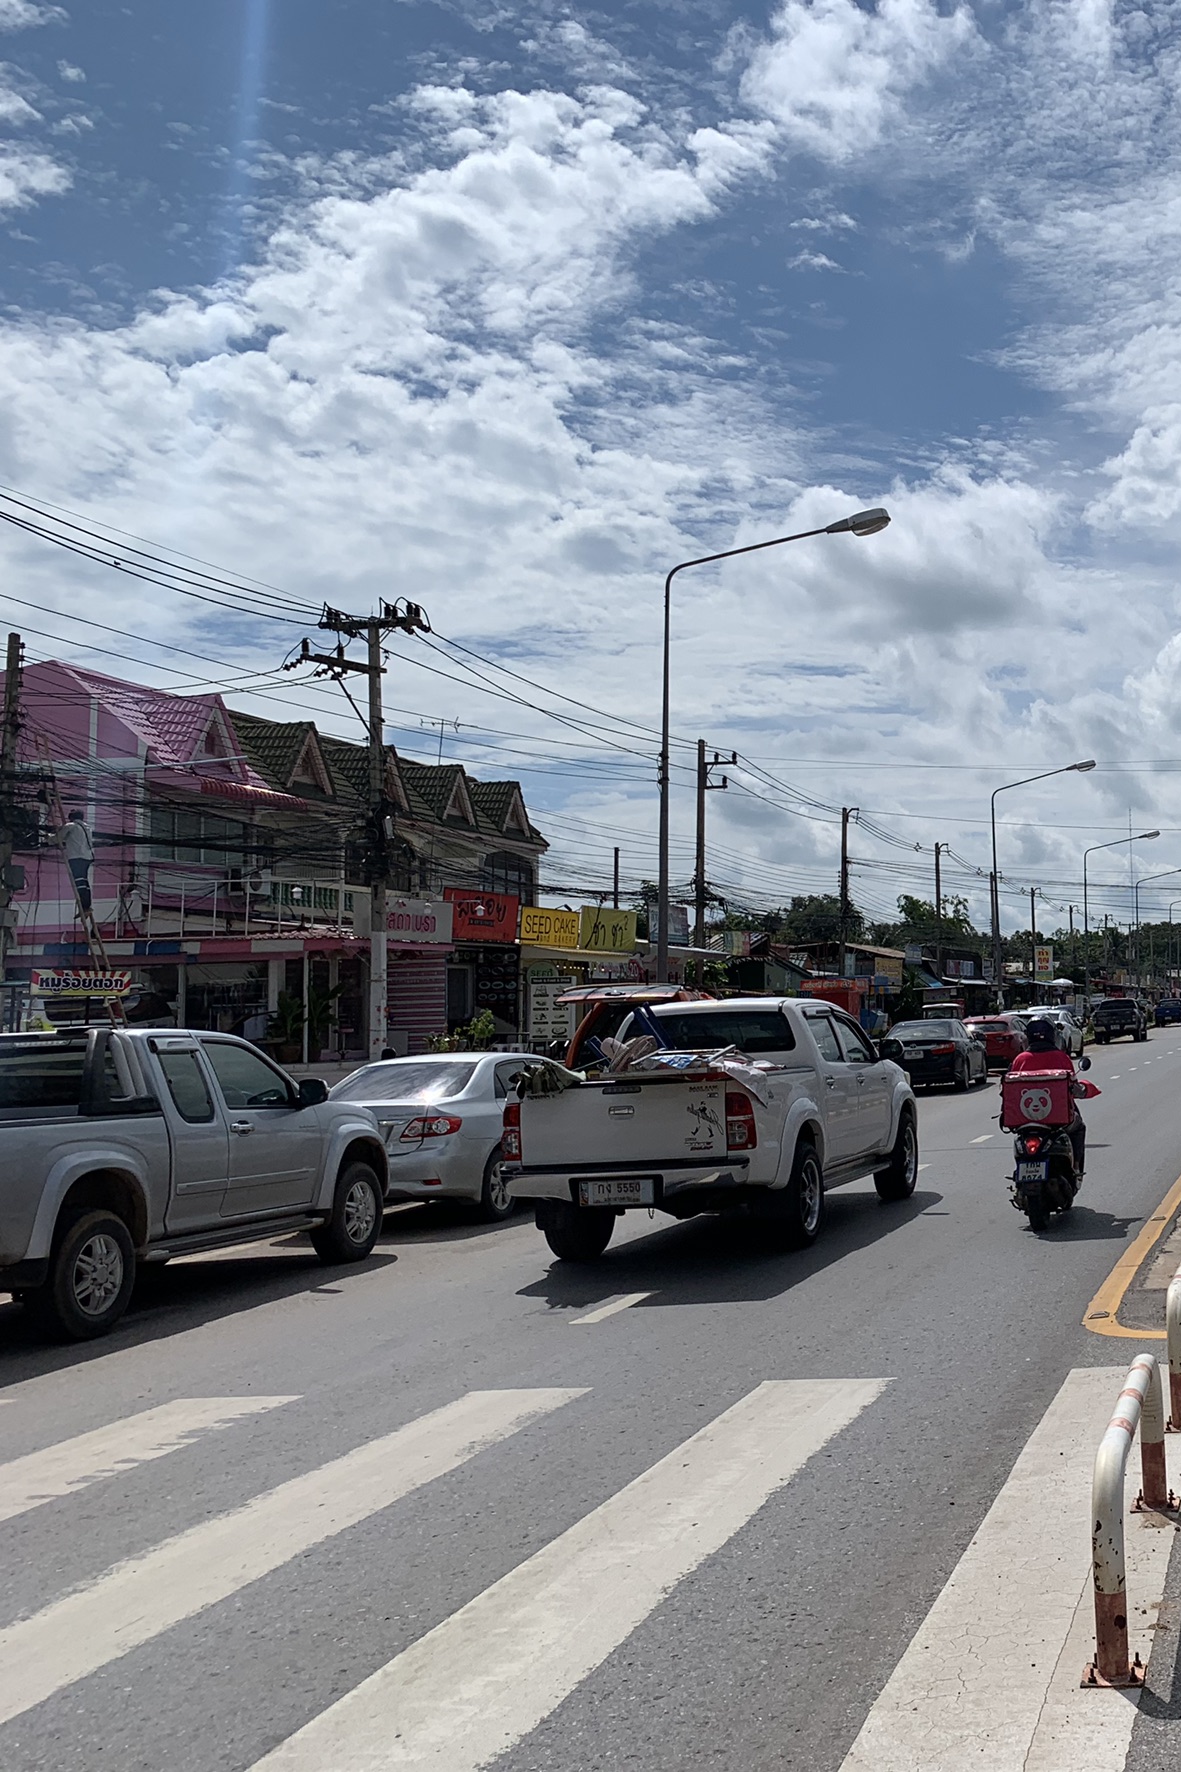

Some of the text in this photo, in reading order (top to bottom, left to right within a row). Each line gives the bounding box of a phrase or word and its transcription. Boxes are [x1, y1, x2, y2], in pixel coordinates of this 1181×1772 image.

[525, 914, 577, 936] SEED CAKE
[616, 1183, 641, 1194] 5550
